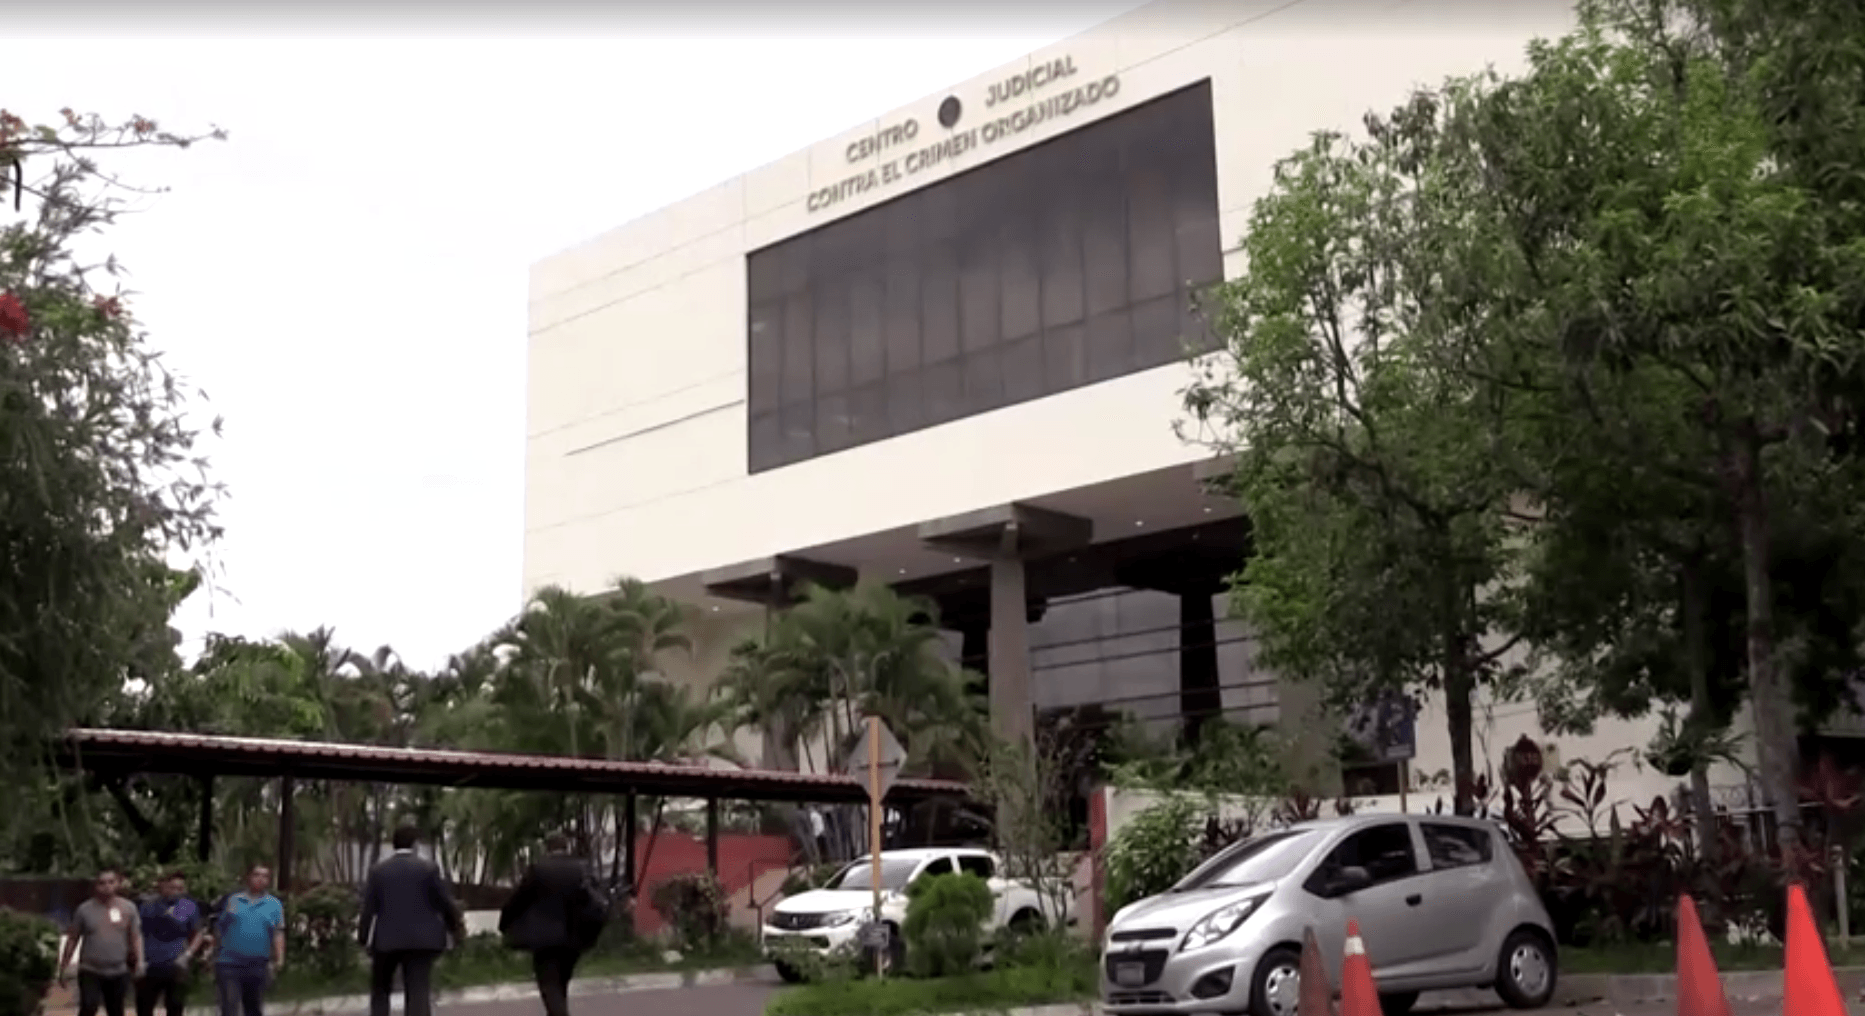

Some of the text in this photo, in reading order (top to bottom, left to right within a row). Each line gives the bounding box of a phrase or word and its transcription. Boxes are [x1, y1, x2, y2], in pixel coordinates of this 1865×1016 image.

[806, 74, 1121, 213] CONTRA EL CRIMEN ORGANIZADO
[846, 55, 1078, 164] CENTRO JUDICIAL
